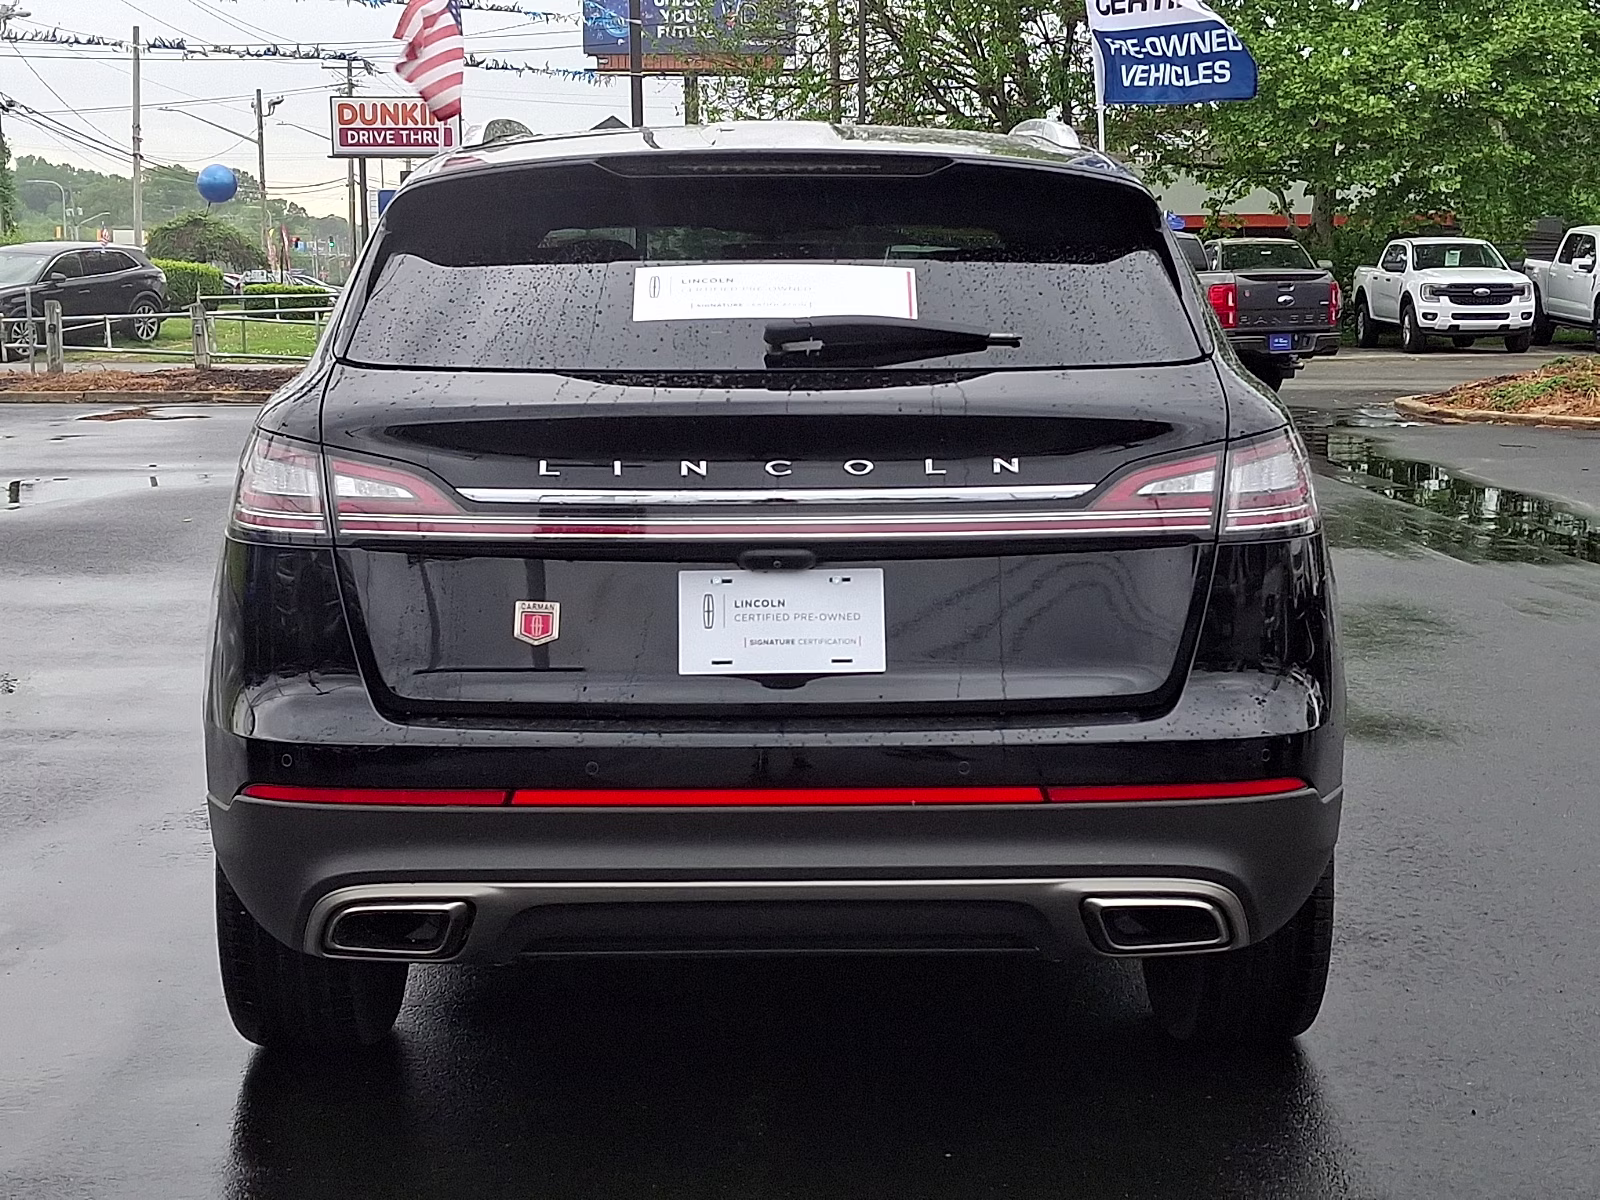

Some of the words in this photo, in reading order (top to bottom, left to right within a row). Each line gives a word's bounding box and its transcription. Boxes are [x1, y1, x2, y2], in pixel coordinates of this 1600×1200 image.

[657, 25, 716, 39] FUTUE
[1104, 29, 1243, 58] PRE-OWNED
[1121, 60, 1231, 87] VEHICLES
[347, 130, 395, 144] DRIVE
[538, 457, 1019, 477] LINCOLN
[734, 599, 786, 609] LINCOLN
[734, 613, 790, 622] CERTIFIED
[794, 612, 861, 621] PRE-OWNED
[749, 638, 796, 646] SIGNATURE
